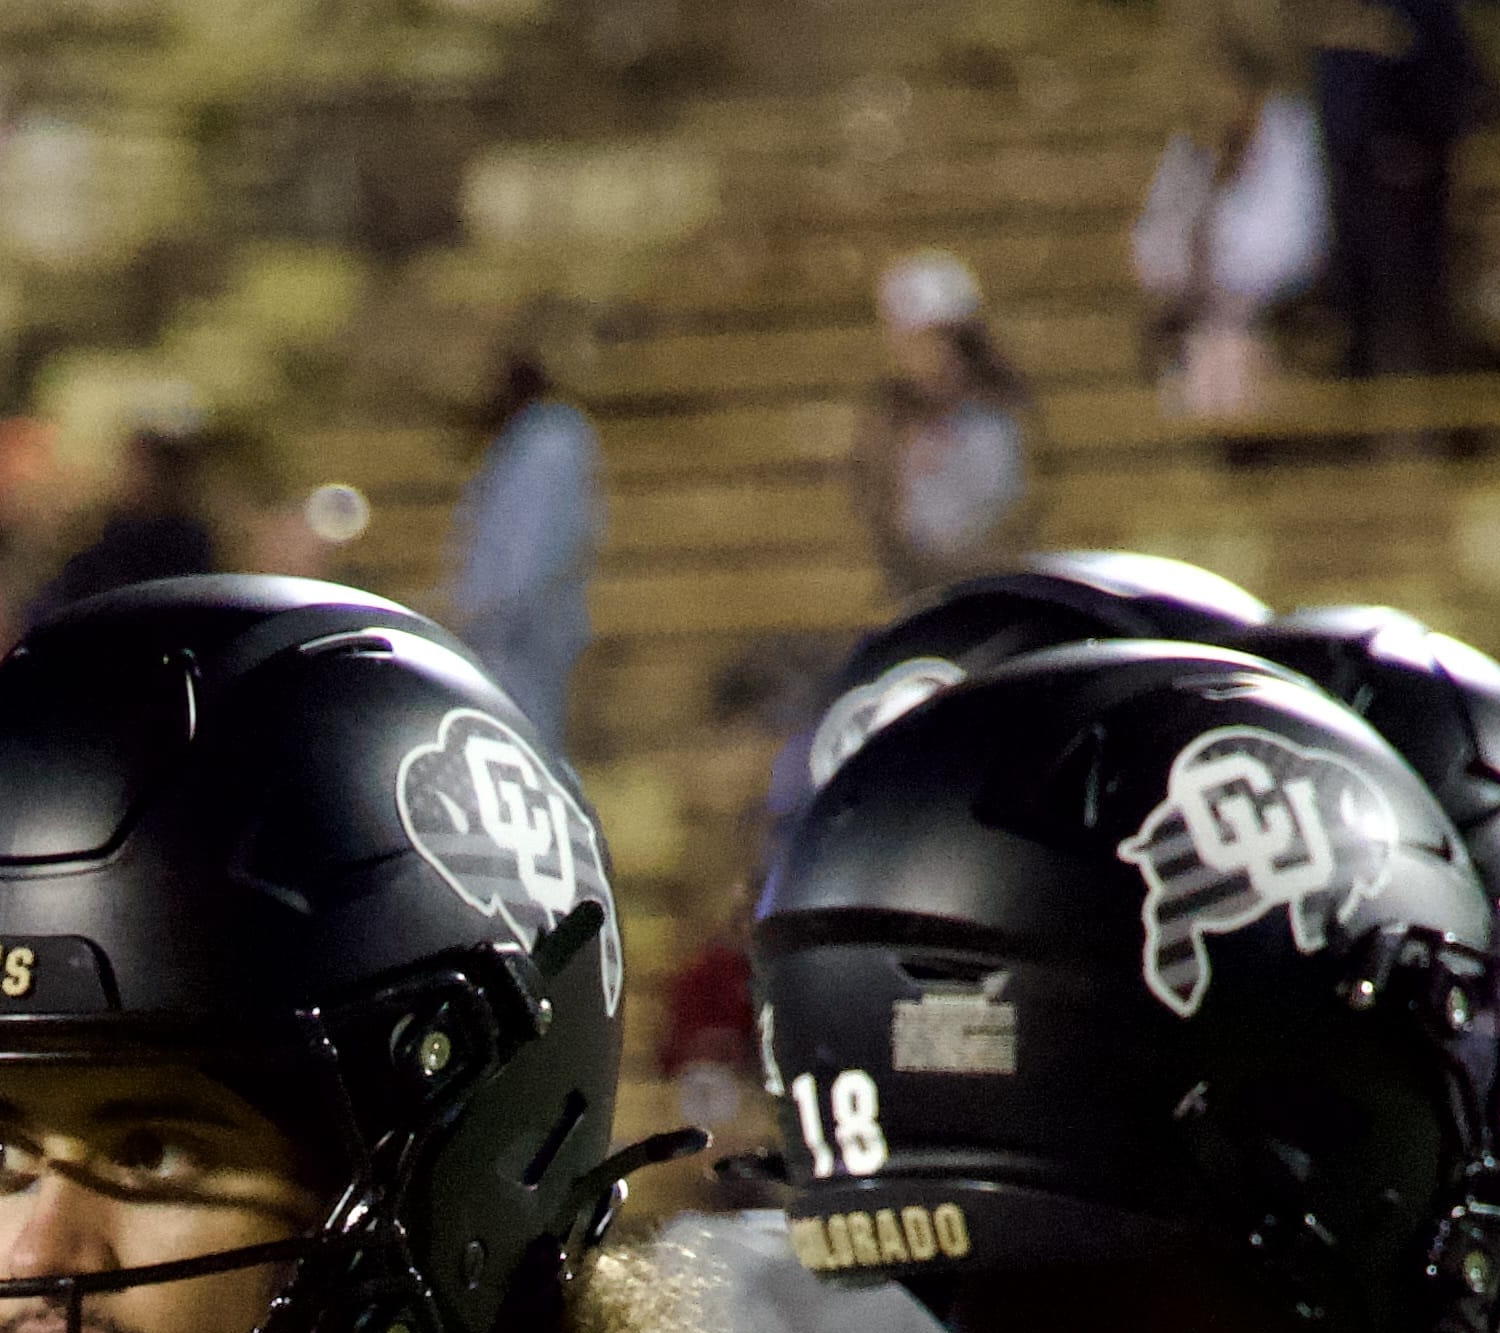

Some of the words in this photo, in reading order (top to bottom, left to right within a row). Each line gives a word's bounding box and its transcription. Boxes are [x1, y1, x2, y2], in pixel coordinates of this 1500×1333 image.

[464, 733, 577, 916] CU
[1170, 752, 1334, 900] CU
[791, 1067, 889, 1180] 18
[790, 1200, 972, 1270] ORADO
